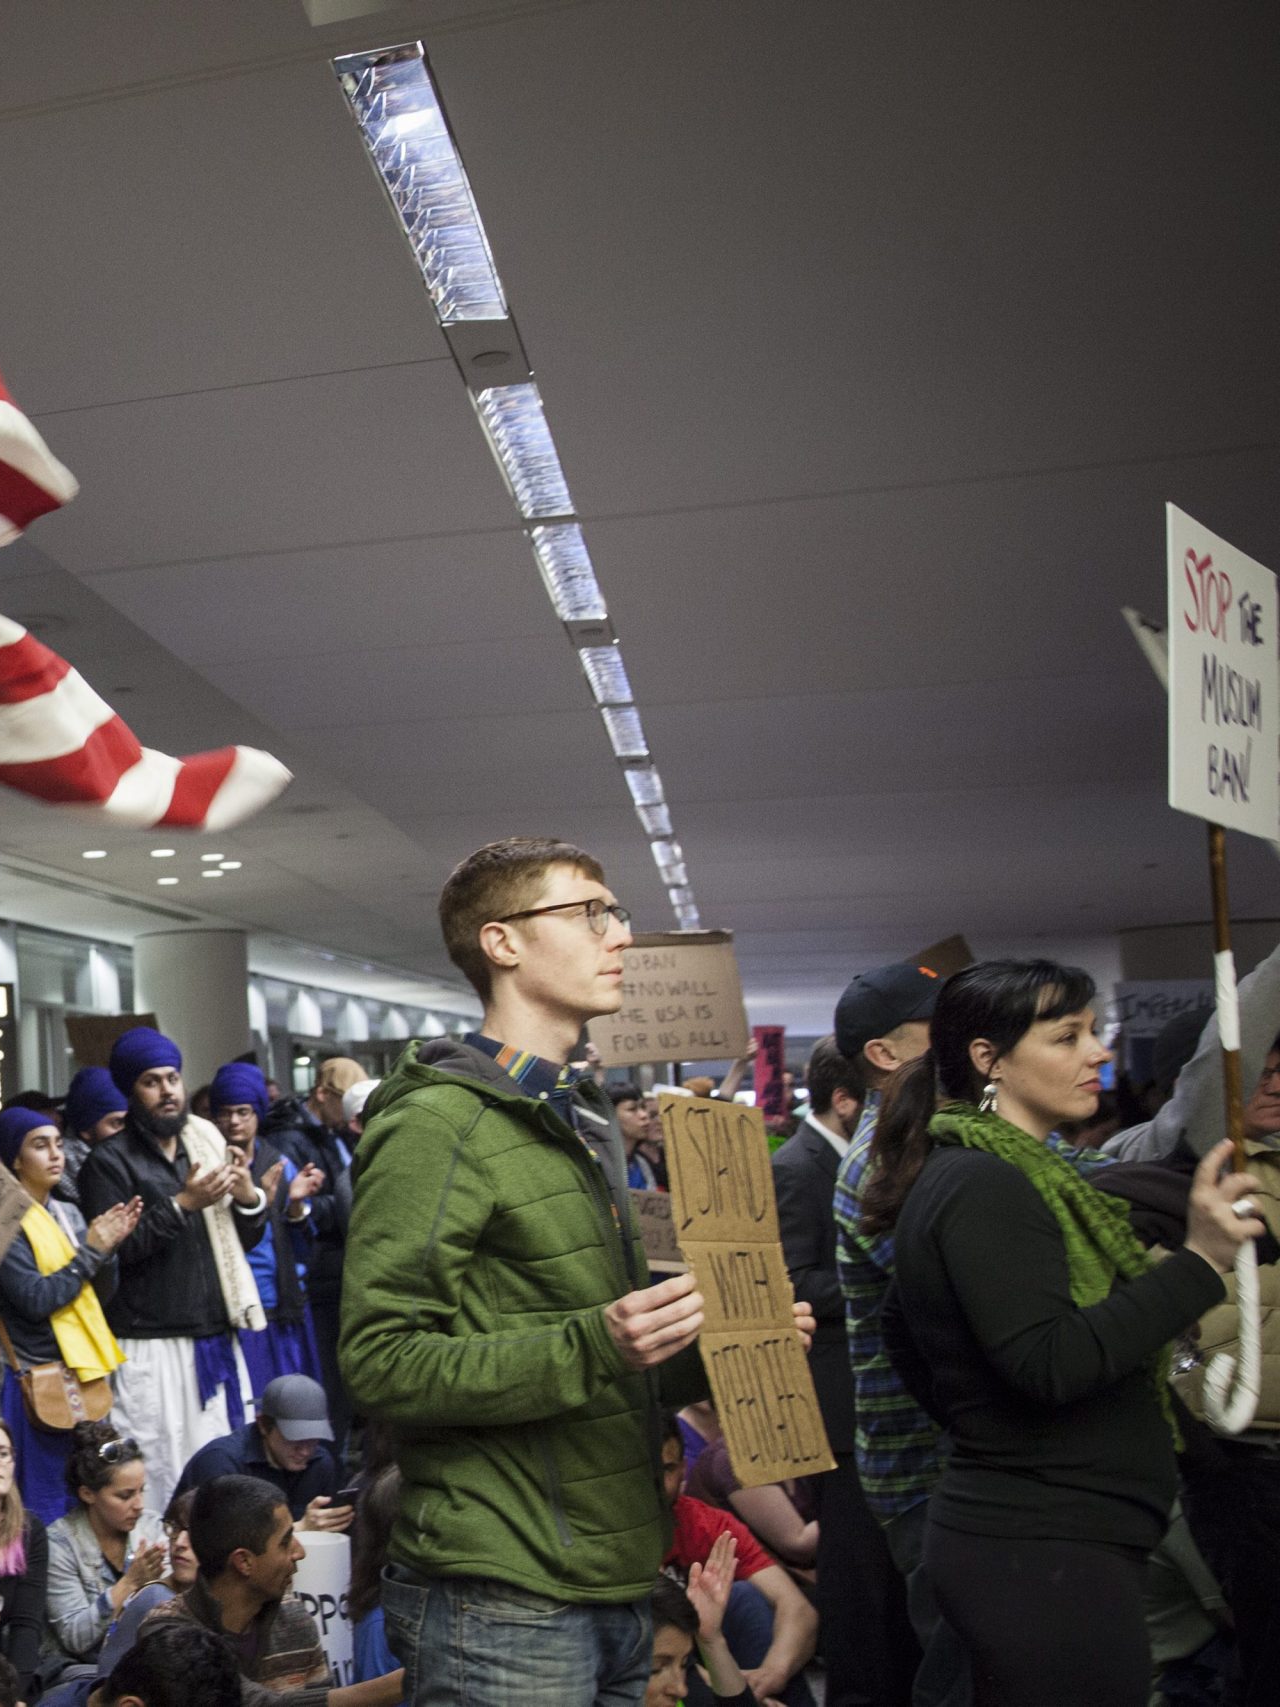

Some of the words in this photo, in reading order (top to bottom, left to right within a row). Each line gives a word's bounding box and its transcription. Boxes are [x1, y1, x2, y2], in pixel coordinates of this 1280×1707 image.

[1183, 547, 1233, 643] STOP
[1238, 591, 1264, 647] THE
[1201, 652, 1263, 733] MUSLIM
[612, 1032, 648, 1052] FOR
[657, 1032, 681, 1049] US
[655, 1005, 689, 1023] USA
[695, 1004, 713, 1021] IS
[663, 1104, 693, 1231] I
[684, 1106, 768, 1223] STAND
[707, 1251, 778, 1320] WITH
